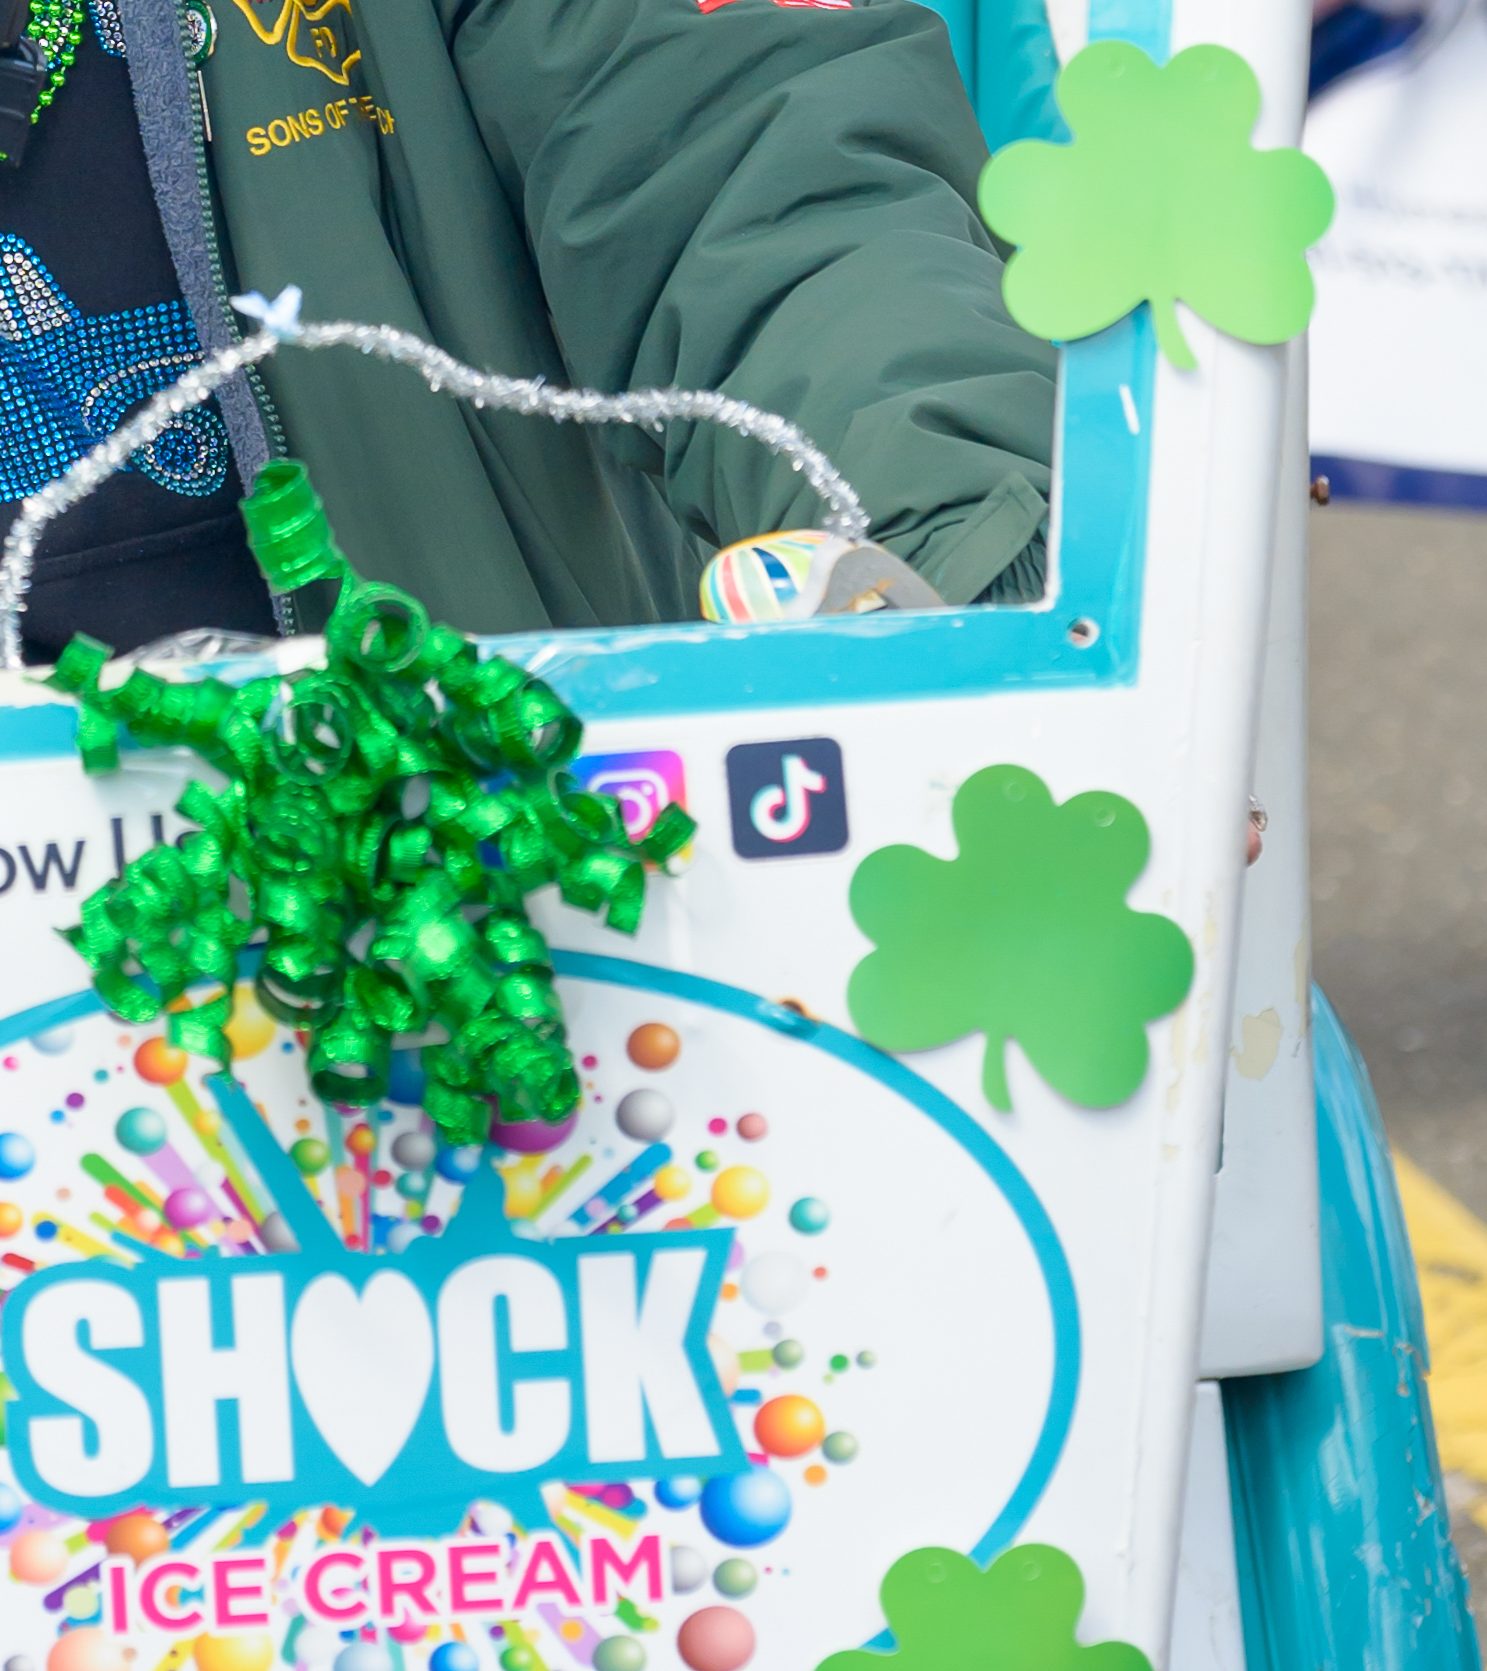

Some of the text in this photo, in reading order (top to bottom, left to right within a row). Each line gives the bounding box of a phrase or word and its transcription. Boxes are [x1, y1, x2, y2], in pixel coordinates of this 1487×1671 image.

[246, 109, 324, 156] SONS
[325, 99, 350, 129] OF
[110, 812, 207, 882] U
[108, 1534, 665, 1634] ICE CREAM
